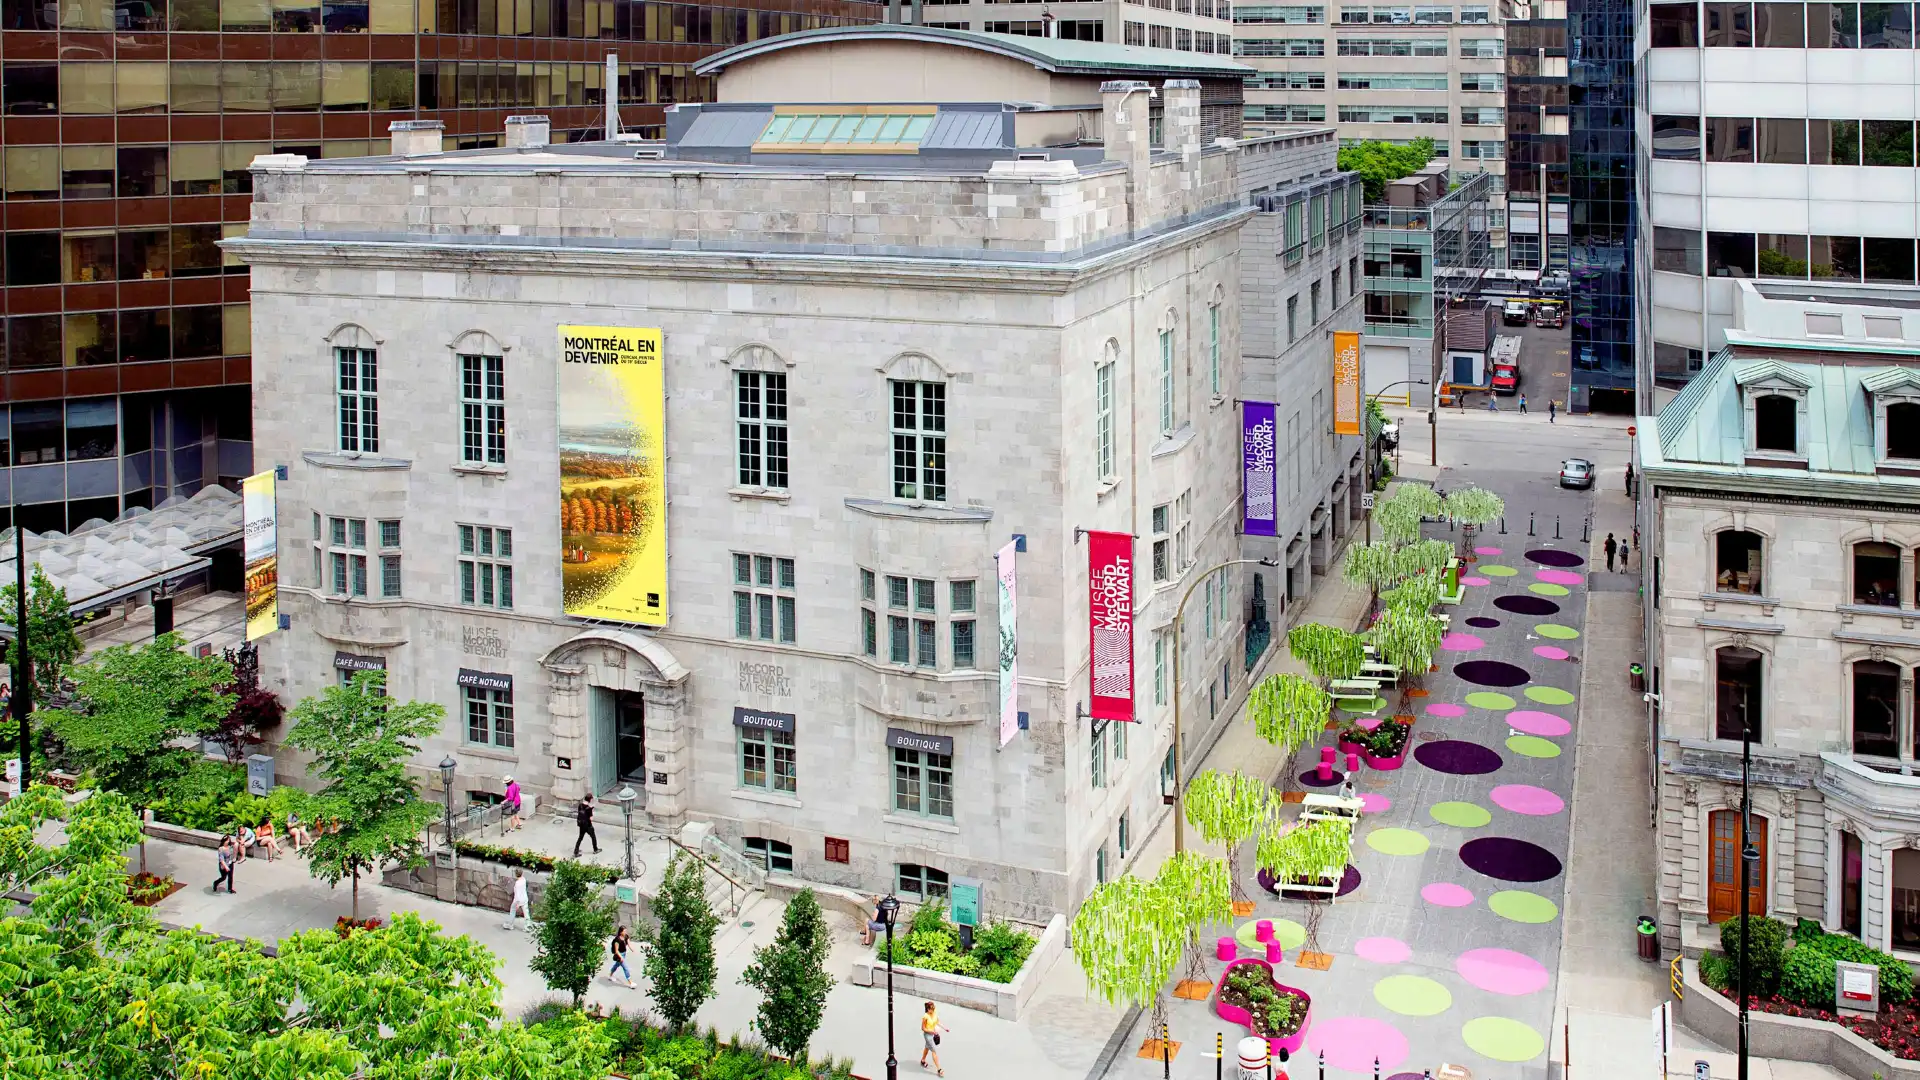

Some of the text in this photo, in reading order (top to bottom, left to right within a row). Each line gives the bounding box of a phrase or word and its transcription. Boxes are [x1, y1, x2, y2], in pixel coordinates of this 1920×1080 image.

[564, 335, 655, 352] MONTRÉAL EN
[564, 351, 619, 365] DEVENIR
[1349, 344, 1357, 386] STEWART
[1254, 424, 1264, 472] McCORD
[1263, 417, 1274, 473] STEWART
[1362, 498, 1373, 507] 30
[1091, 568, 1105, 629] MUSÉE
[1104, 564, 1117, 631] McCORD
[1116, 555, 1130, 633] STEWART
[462, 625, 499, 638] MUSÉE
[463, 635, 502, 648] McCORD
[463, 644, 508, 658] STEWART
[335, 658, 383, 670] CAFÉ NOTMAN
[739, 661, 784, 676] McCORD
[459, 675, 510, 689] CAFÉ NOTMAN
[739, 672, 791, 687] STEWART
[739, 682, 791, 697] MUSEUM
[743, 715, 784, 728] BOUTIQUE
[897, 736, 941, 750] BOUTIQUE
